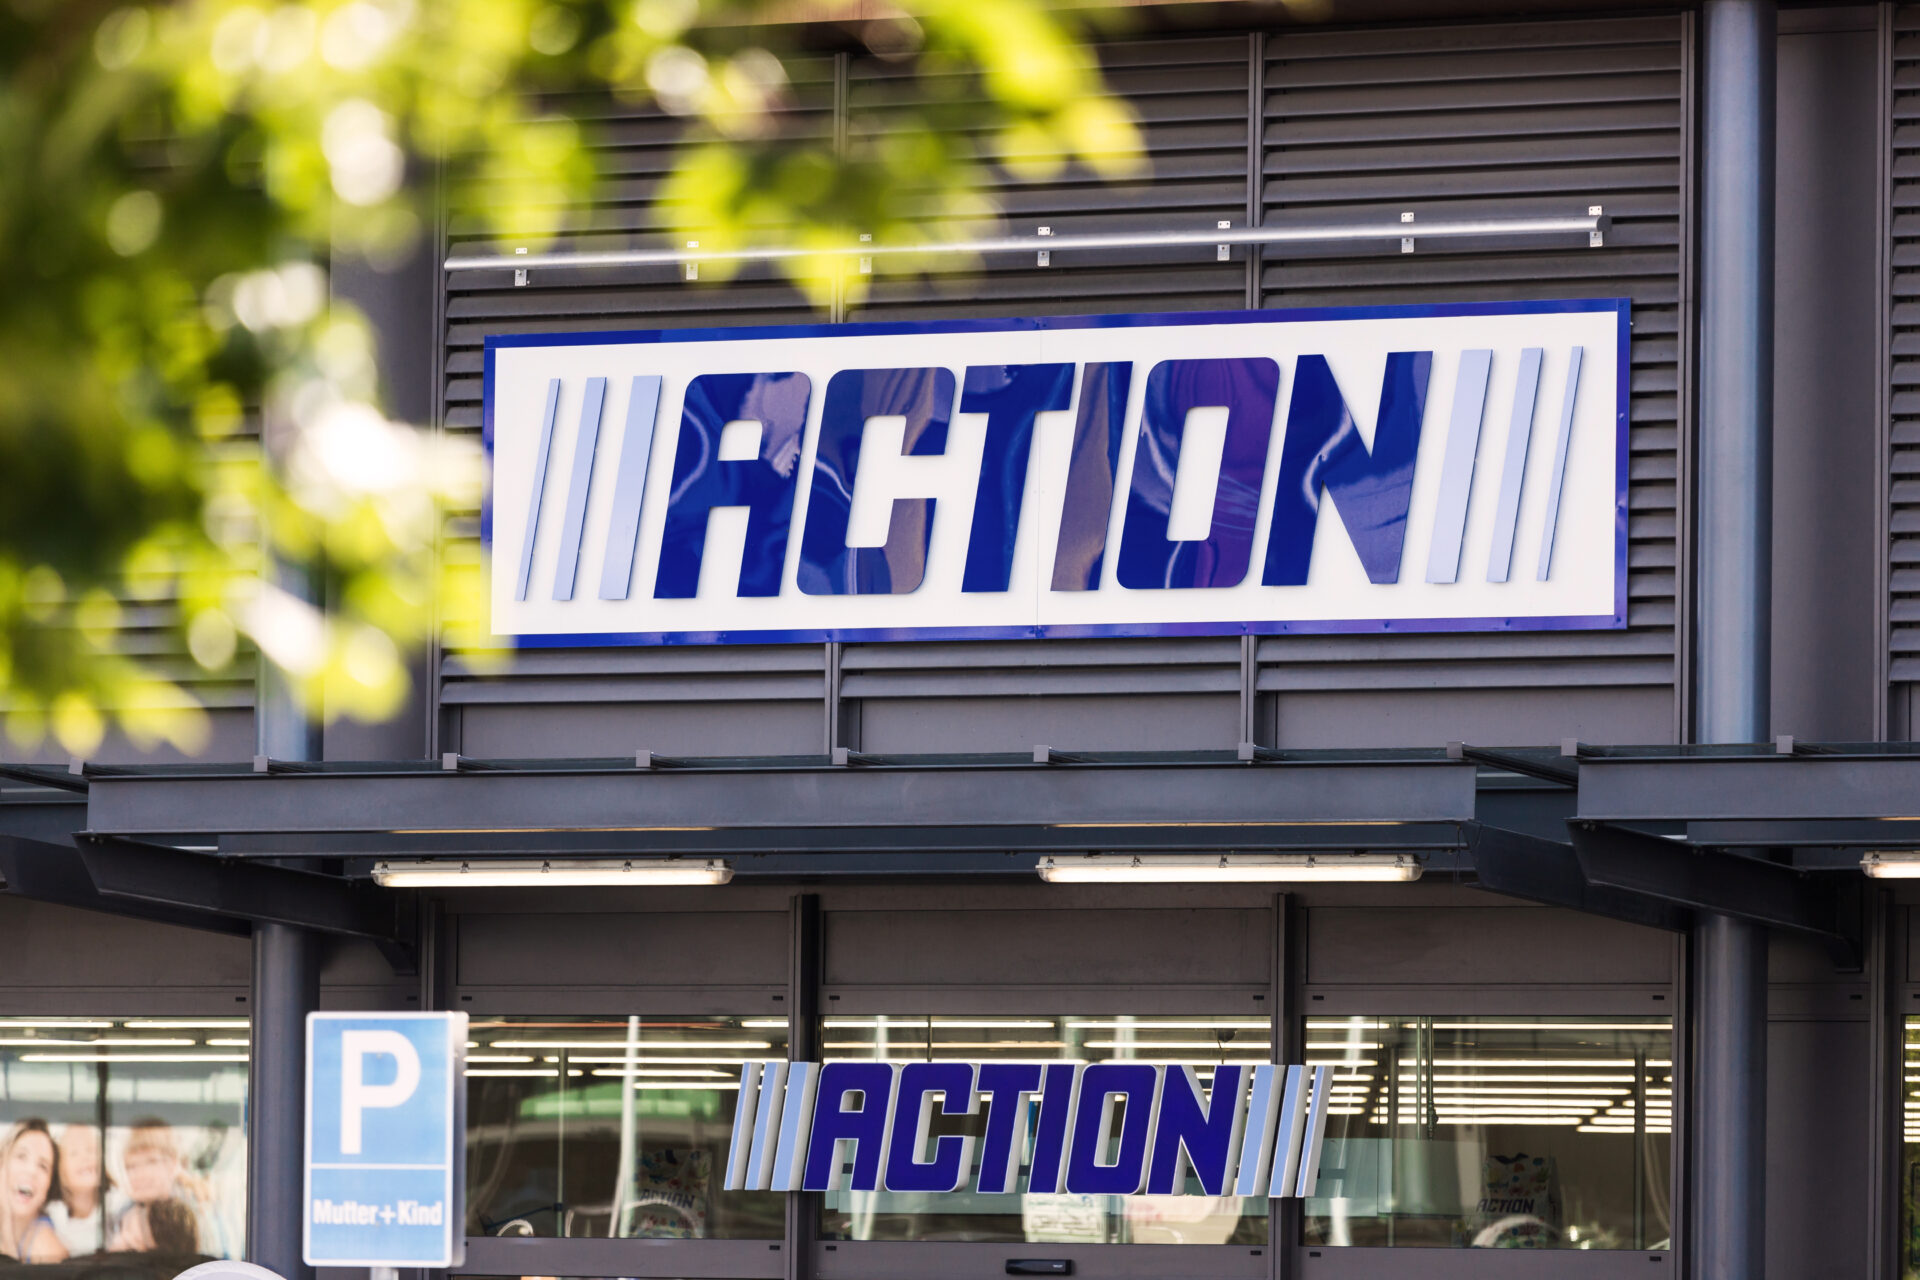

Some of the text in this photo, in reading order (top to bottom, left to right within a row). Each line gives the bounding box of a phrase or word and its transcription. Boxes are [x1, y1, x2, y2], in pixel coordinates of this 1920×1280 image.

[653, 351, 1433, 599] ACTION
[340, 1030, 421, 1154] P
[803, 1062, 1241, 1197] ACTION
[1476, 1198, 1535, 1213] ACTION
